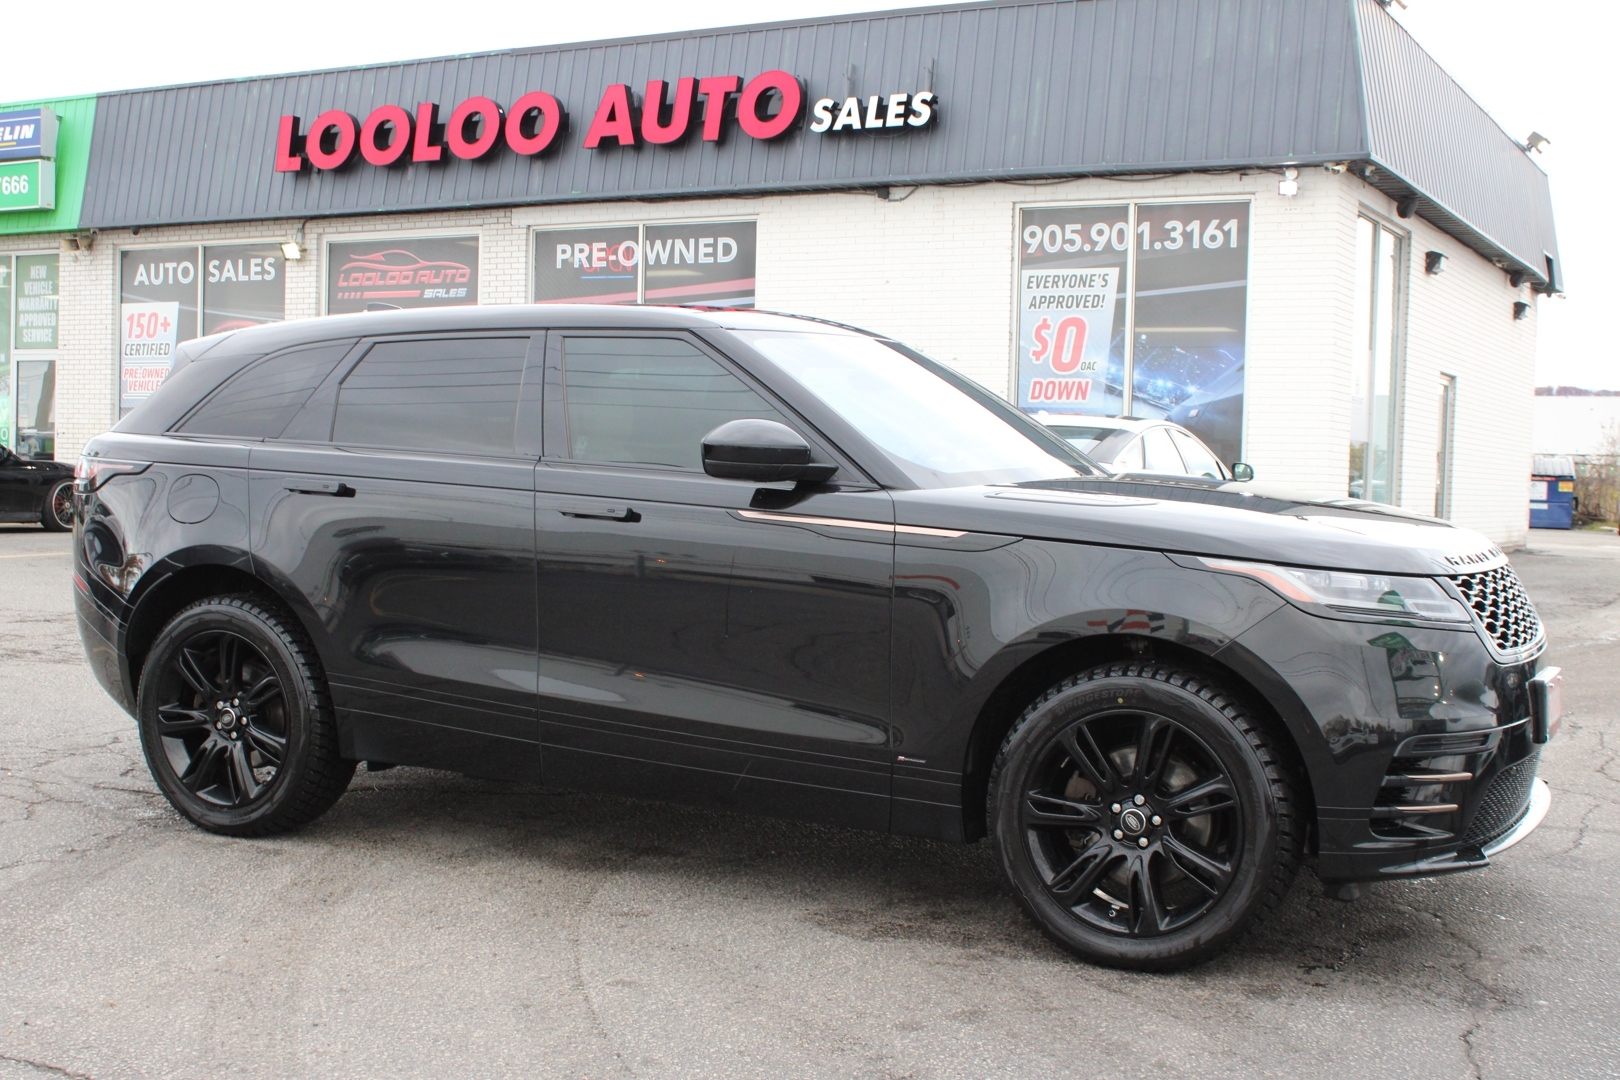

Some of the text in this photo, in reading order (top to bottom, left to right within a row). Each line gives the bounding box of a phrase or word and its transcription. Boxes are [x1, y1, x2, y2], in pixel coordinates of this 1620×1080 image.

[275, 70, 935, 172] LOOLOO AUTO SALES
[0, 175, 29, 195] 666
[1023, 219, 1239, 254] 905.901.3161
[556, 237, 738, 269] PRE-OWNED
[30, 265, 47, 279] NEW
[134, 257, 276, 286] AUTO SALES
[337, 269, 471, 287] LOOLOO AUTO
[24, 281, 53, 295] VEHICLE
[1026, 273, 1110, 290] EVERYONE'S
[423, 288, 468, 298] SALES
[18, 297, 59, 311] WARRANTY
[1028, 294, 1106, 310] APPROVED!
[19, 313, 57, 327] APPROVED
[126, 312, 171, 339] 150+
[22, 329, 53, 343] SERVICE
[124, 343, 171, 356] CERTIFIED
[1031, 317, 1097, 373] $0 OAC
[123, 368, 170, 379] PRE-OWNED
[1029, 380, 1091, 401] DOWN
